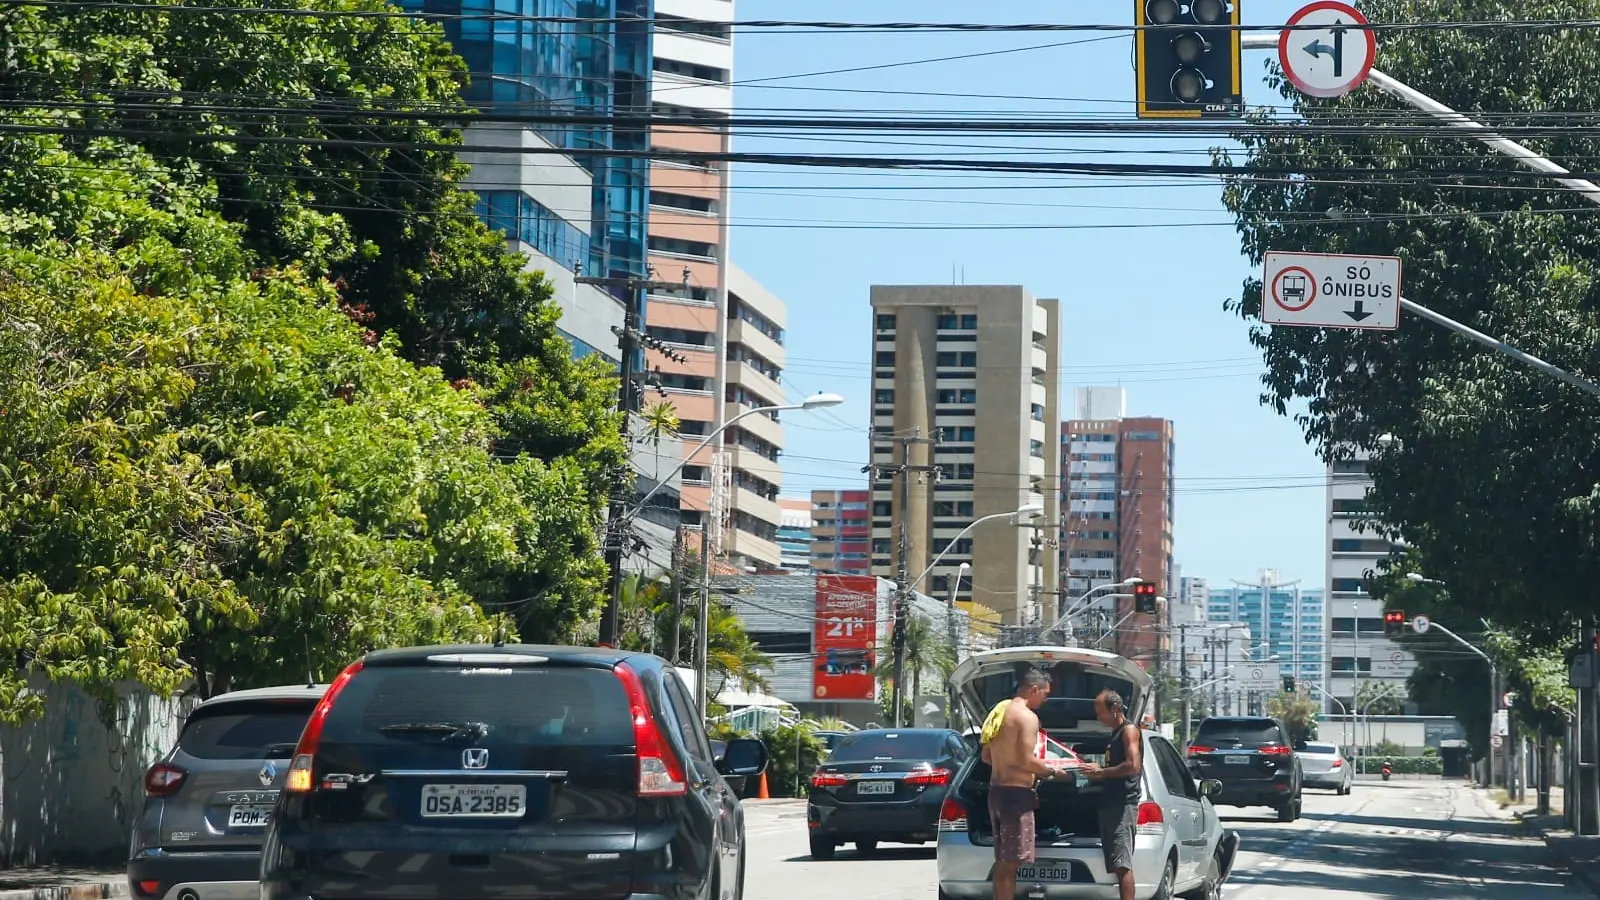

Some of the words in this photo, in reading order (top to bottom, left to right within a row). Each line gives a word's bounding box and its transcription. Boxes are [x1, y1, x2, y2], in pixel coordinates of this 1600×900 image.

[1347, 261, 1370, 280] SÓ
[1322, 276, 1392, 298] ÔNIBUS
[232, 811, 272, 825] POM-2
